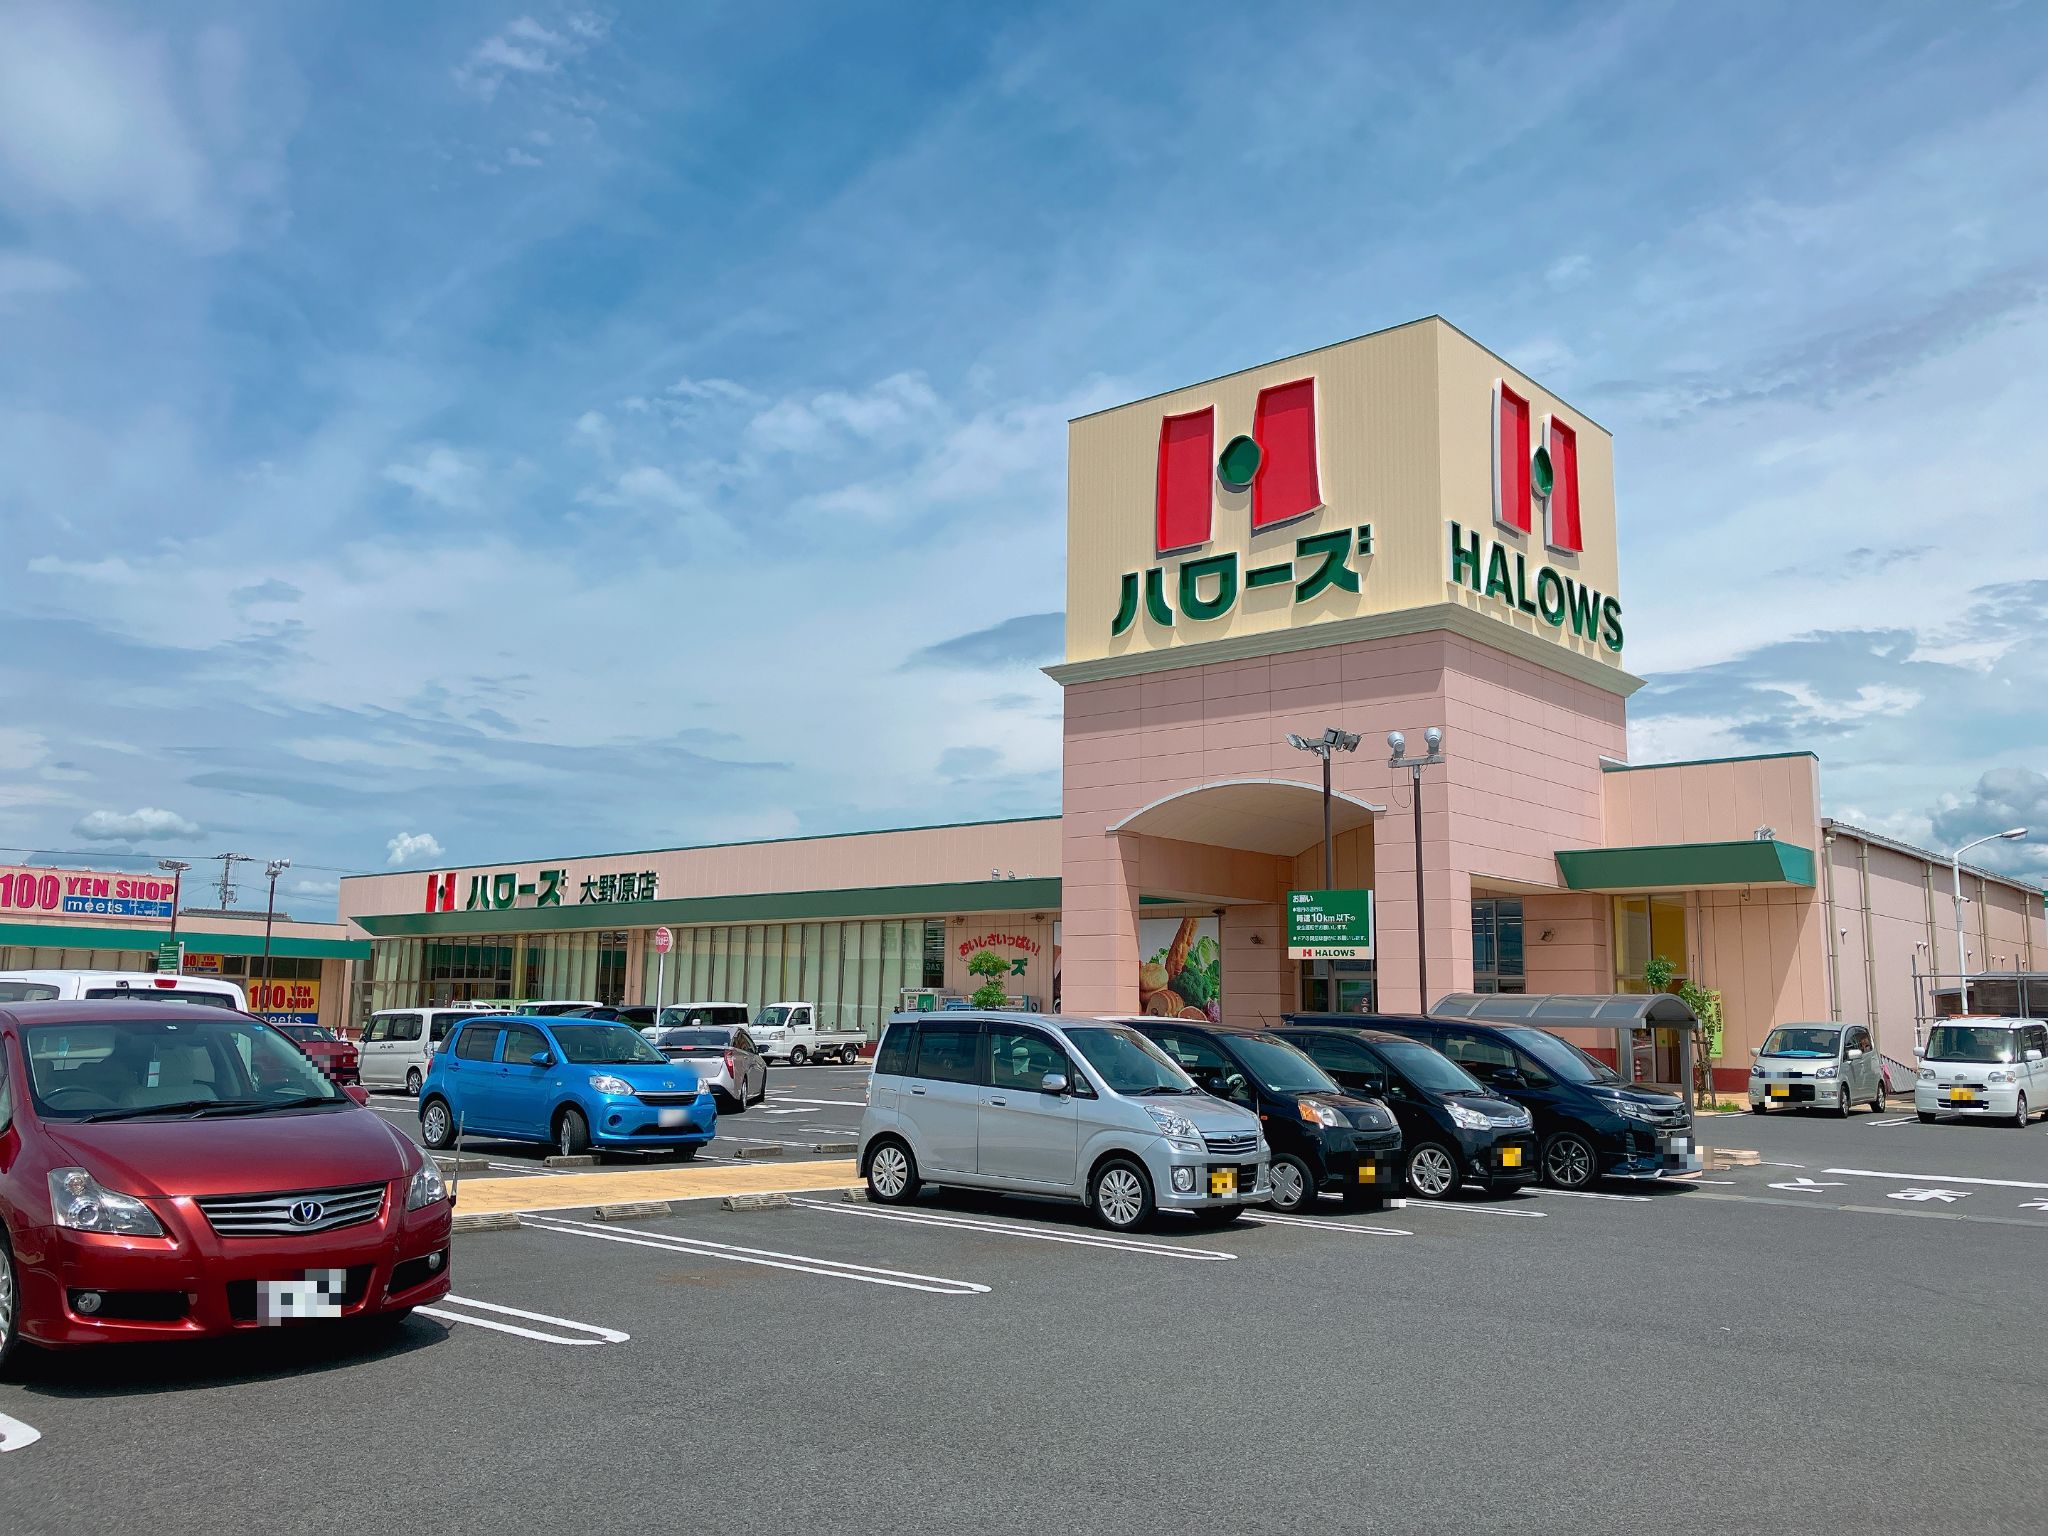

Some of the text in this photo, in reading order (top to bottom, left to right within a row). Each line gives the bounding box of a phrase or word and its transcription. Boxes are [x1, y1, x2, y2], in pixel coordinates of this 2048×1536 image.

[1111, 522, 1374, 638] ハローズ
[1445, 520, 1624, 654] HALOWS
[0, 873, 174, 910] 100 YEN SHOP
[466, 869, 660, 911] ハローズ 大野原店
[1292, 894, 1314, 903] お願い
[1315, 949, 1356, 957] HALOWS
[249, 985, 286, 1008] 100
[286, 997, 315, 1008] SHOP
[290, 985, 311, 997] YEN
